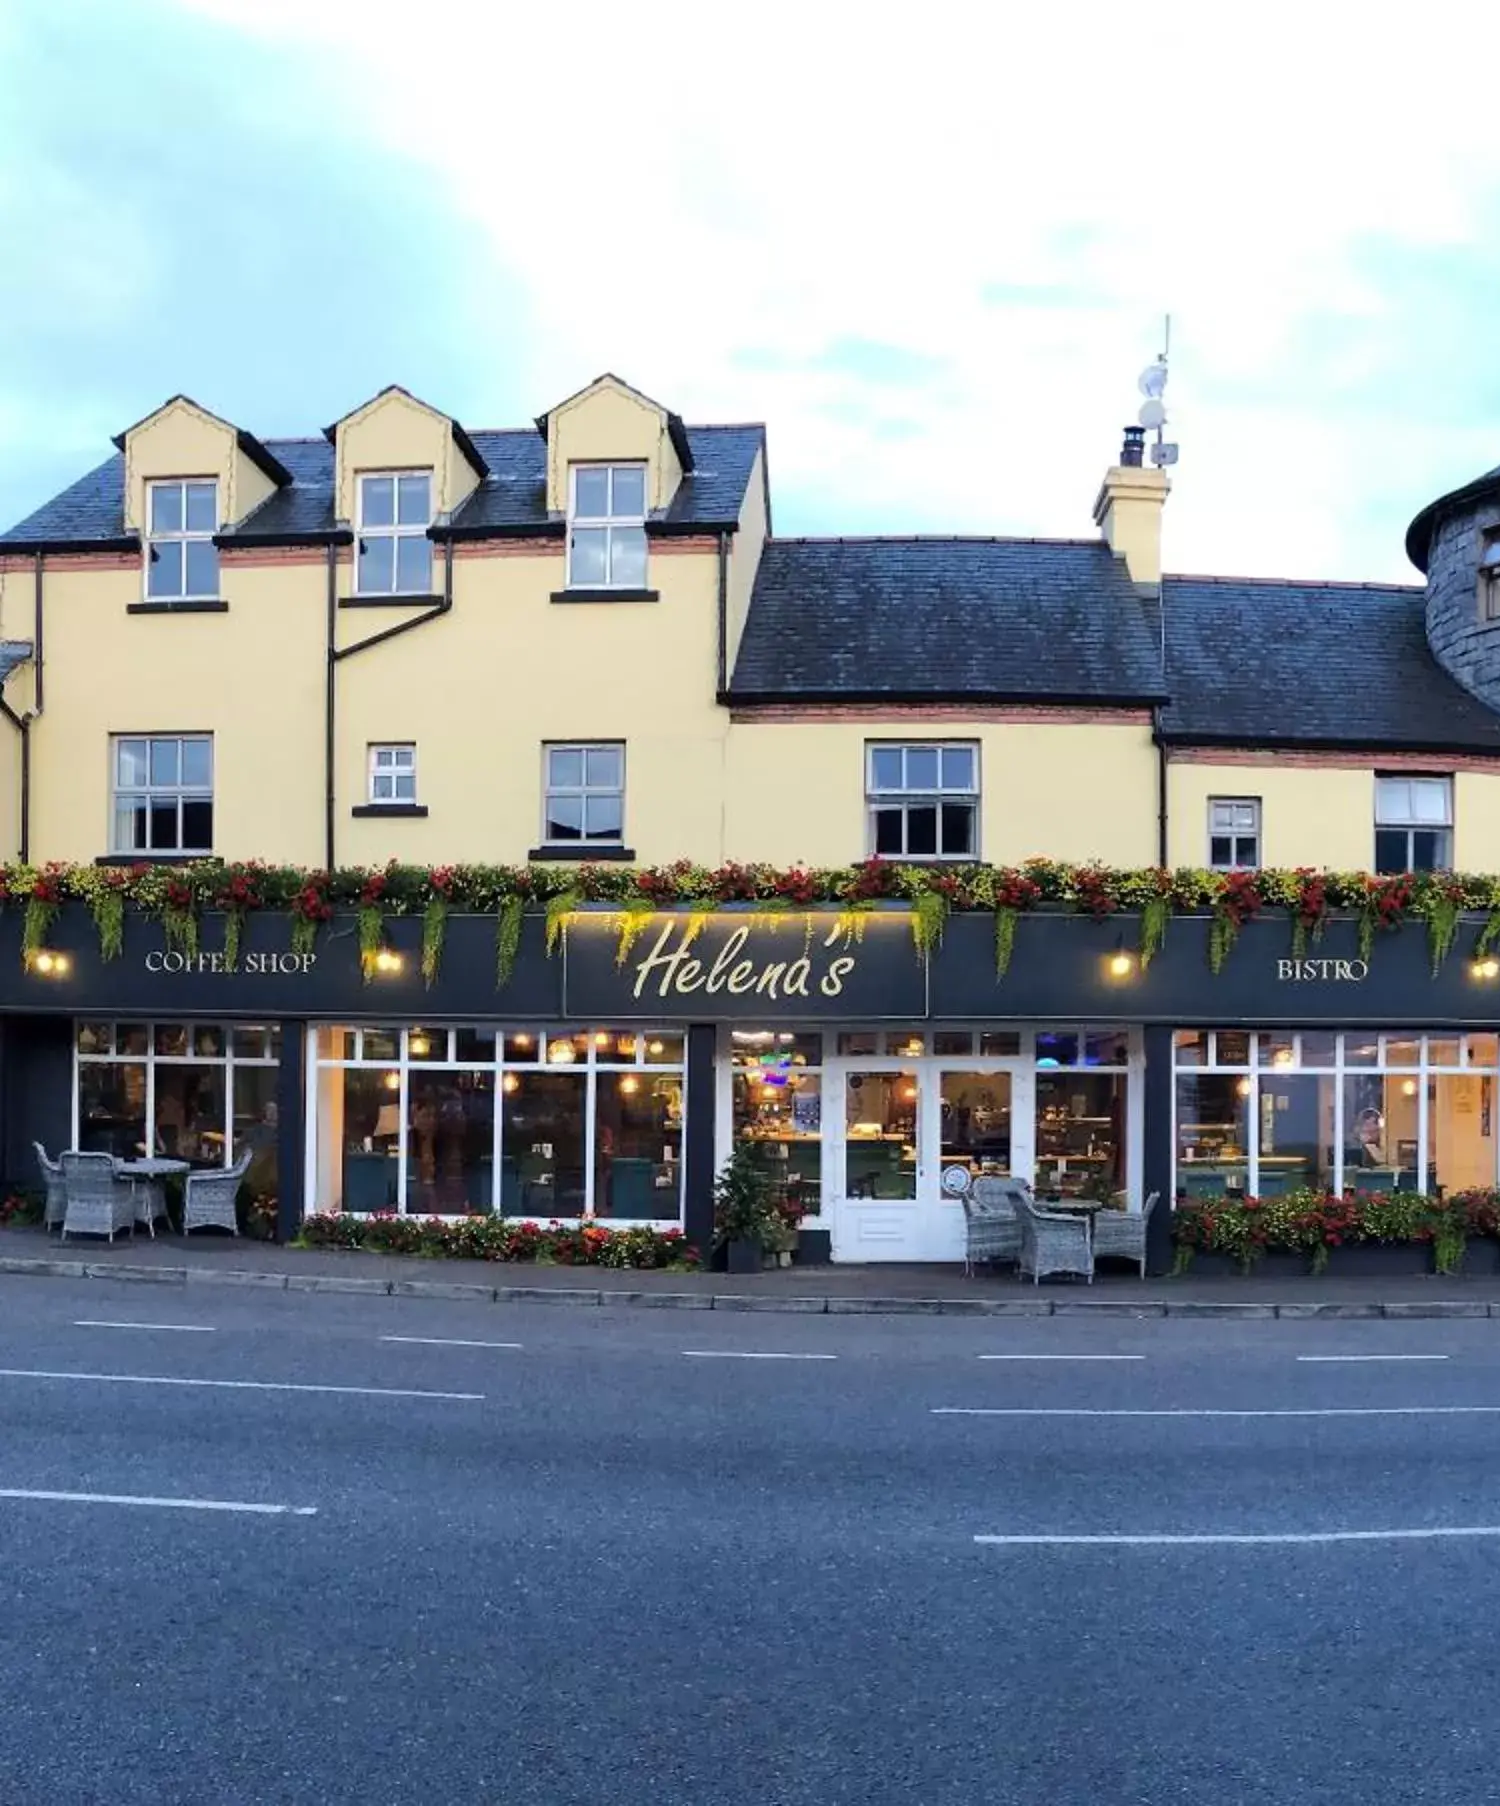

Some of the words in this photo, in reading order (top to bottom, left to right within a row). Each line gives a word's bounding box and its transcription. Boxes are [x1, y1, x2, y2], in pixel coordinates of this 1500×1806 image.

[244, 953, 317, 973] SHOP
[633, 919, 856, 999] Helena's
[1277, 959, 1369, 981] BISTRO
